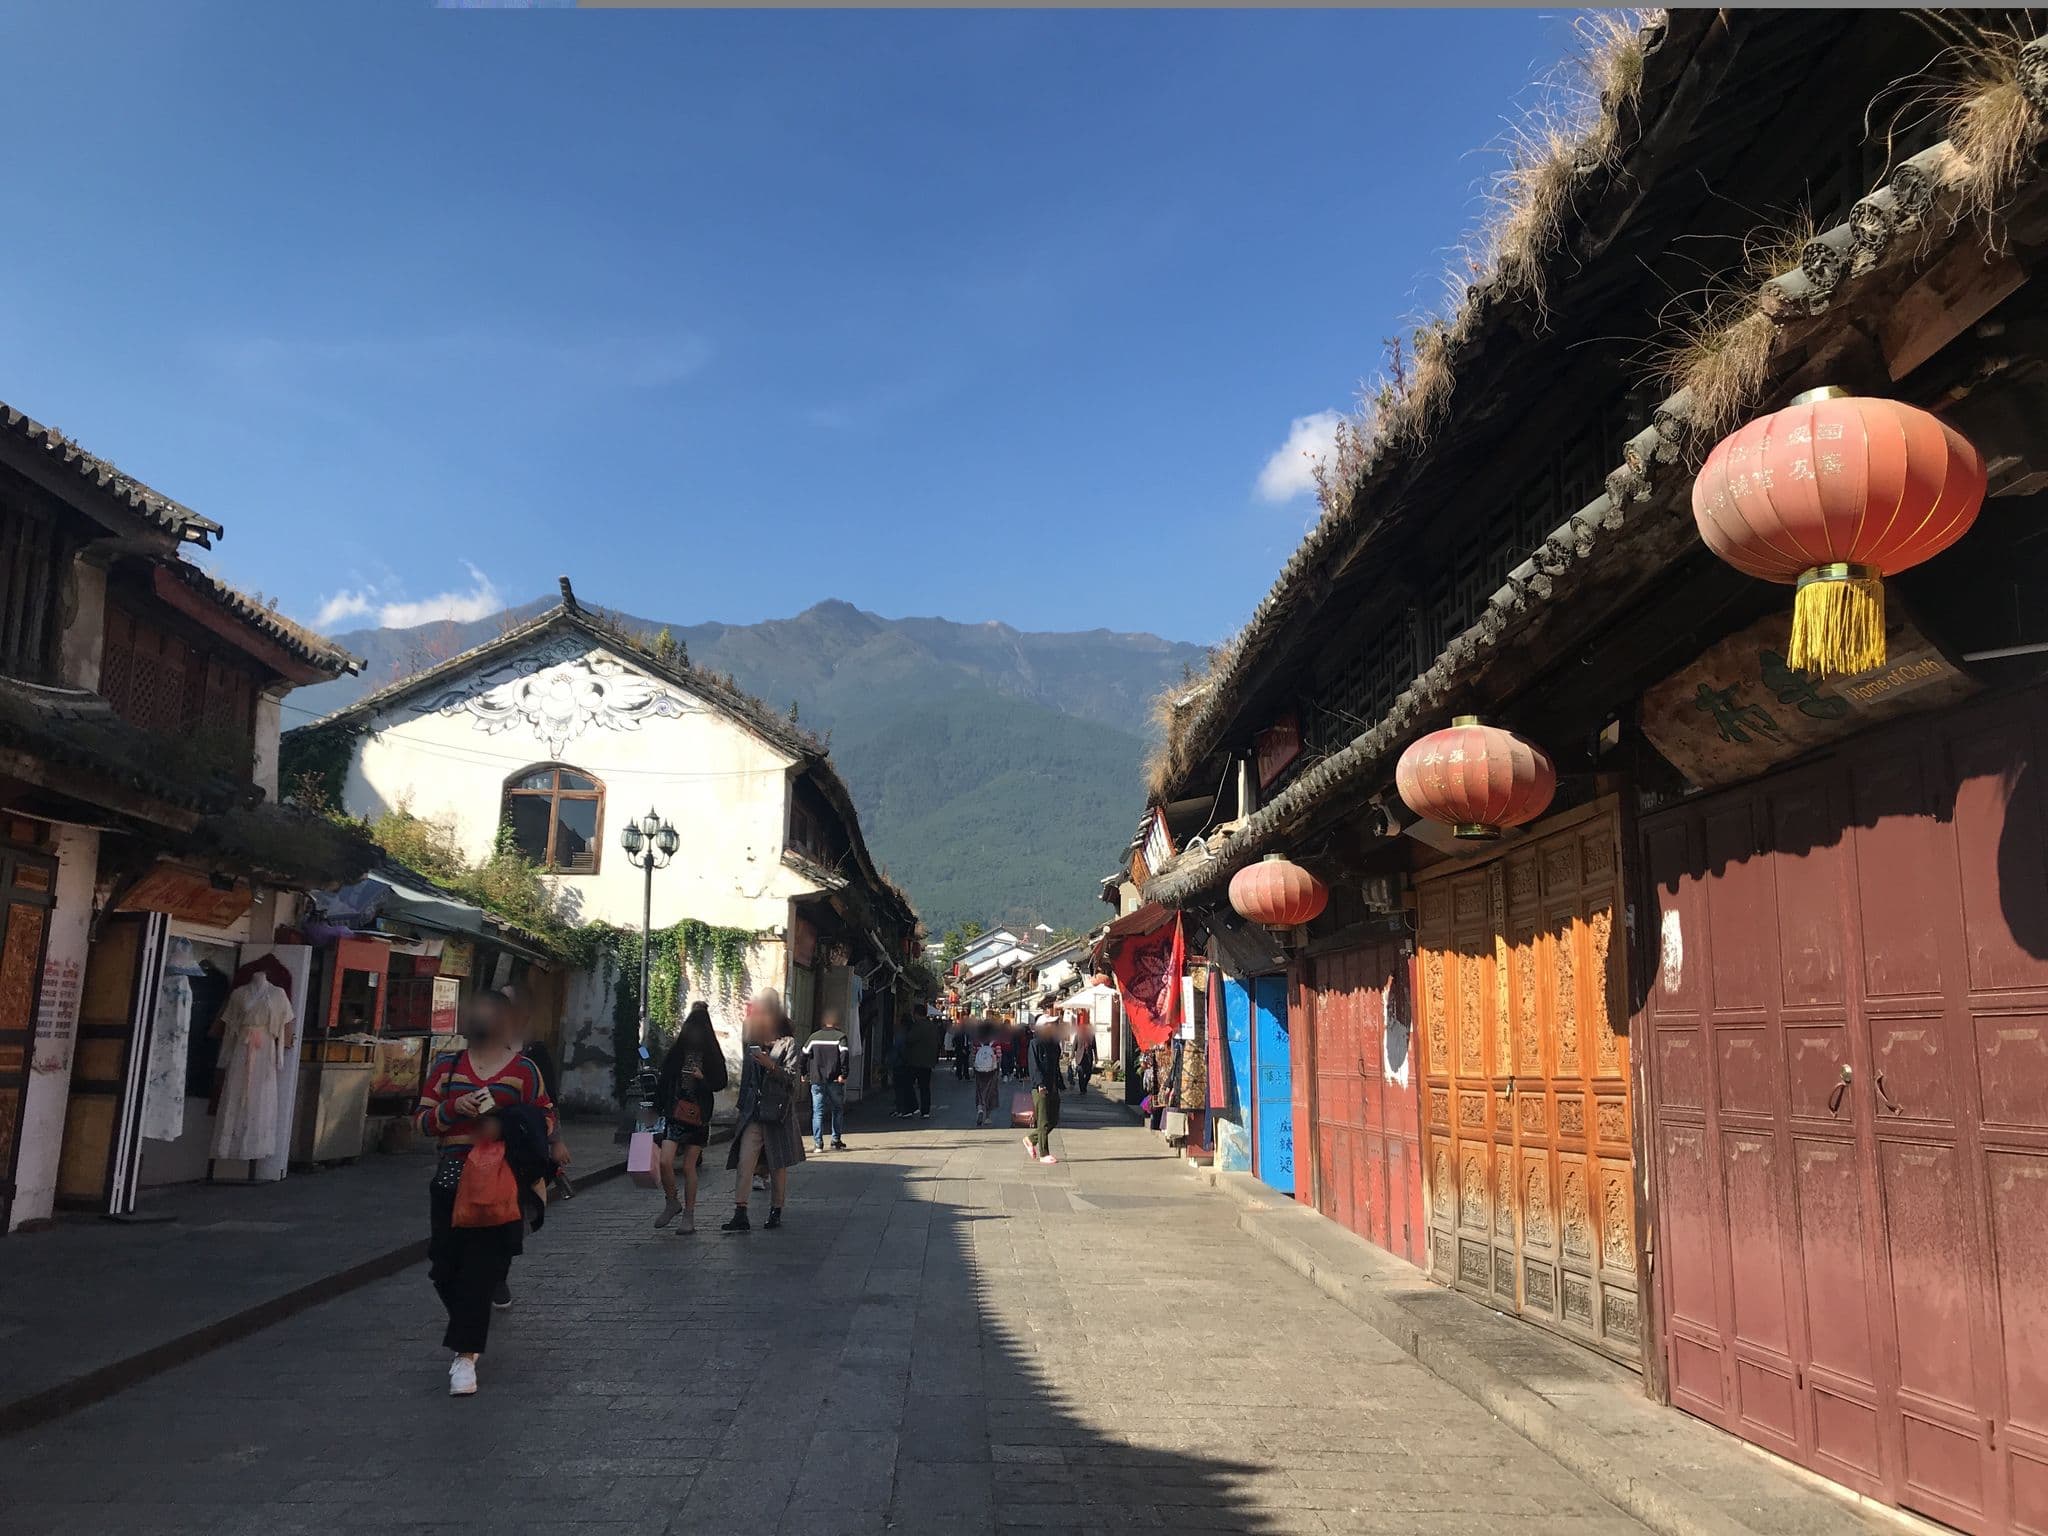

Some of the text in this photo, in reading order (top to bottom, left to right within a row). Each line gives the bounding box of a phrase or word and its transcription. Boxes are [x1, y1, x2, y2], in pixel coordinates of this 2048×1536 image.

[1846, 658, 1943, 701] Home of Cloth
